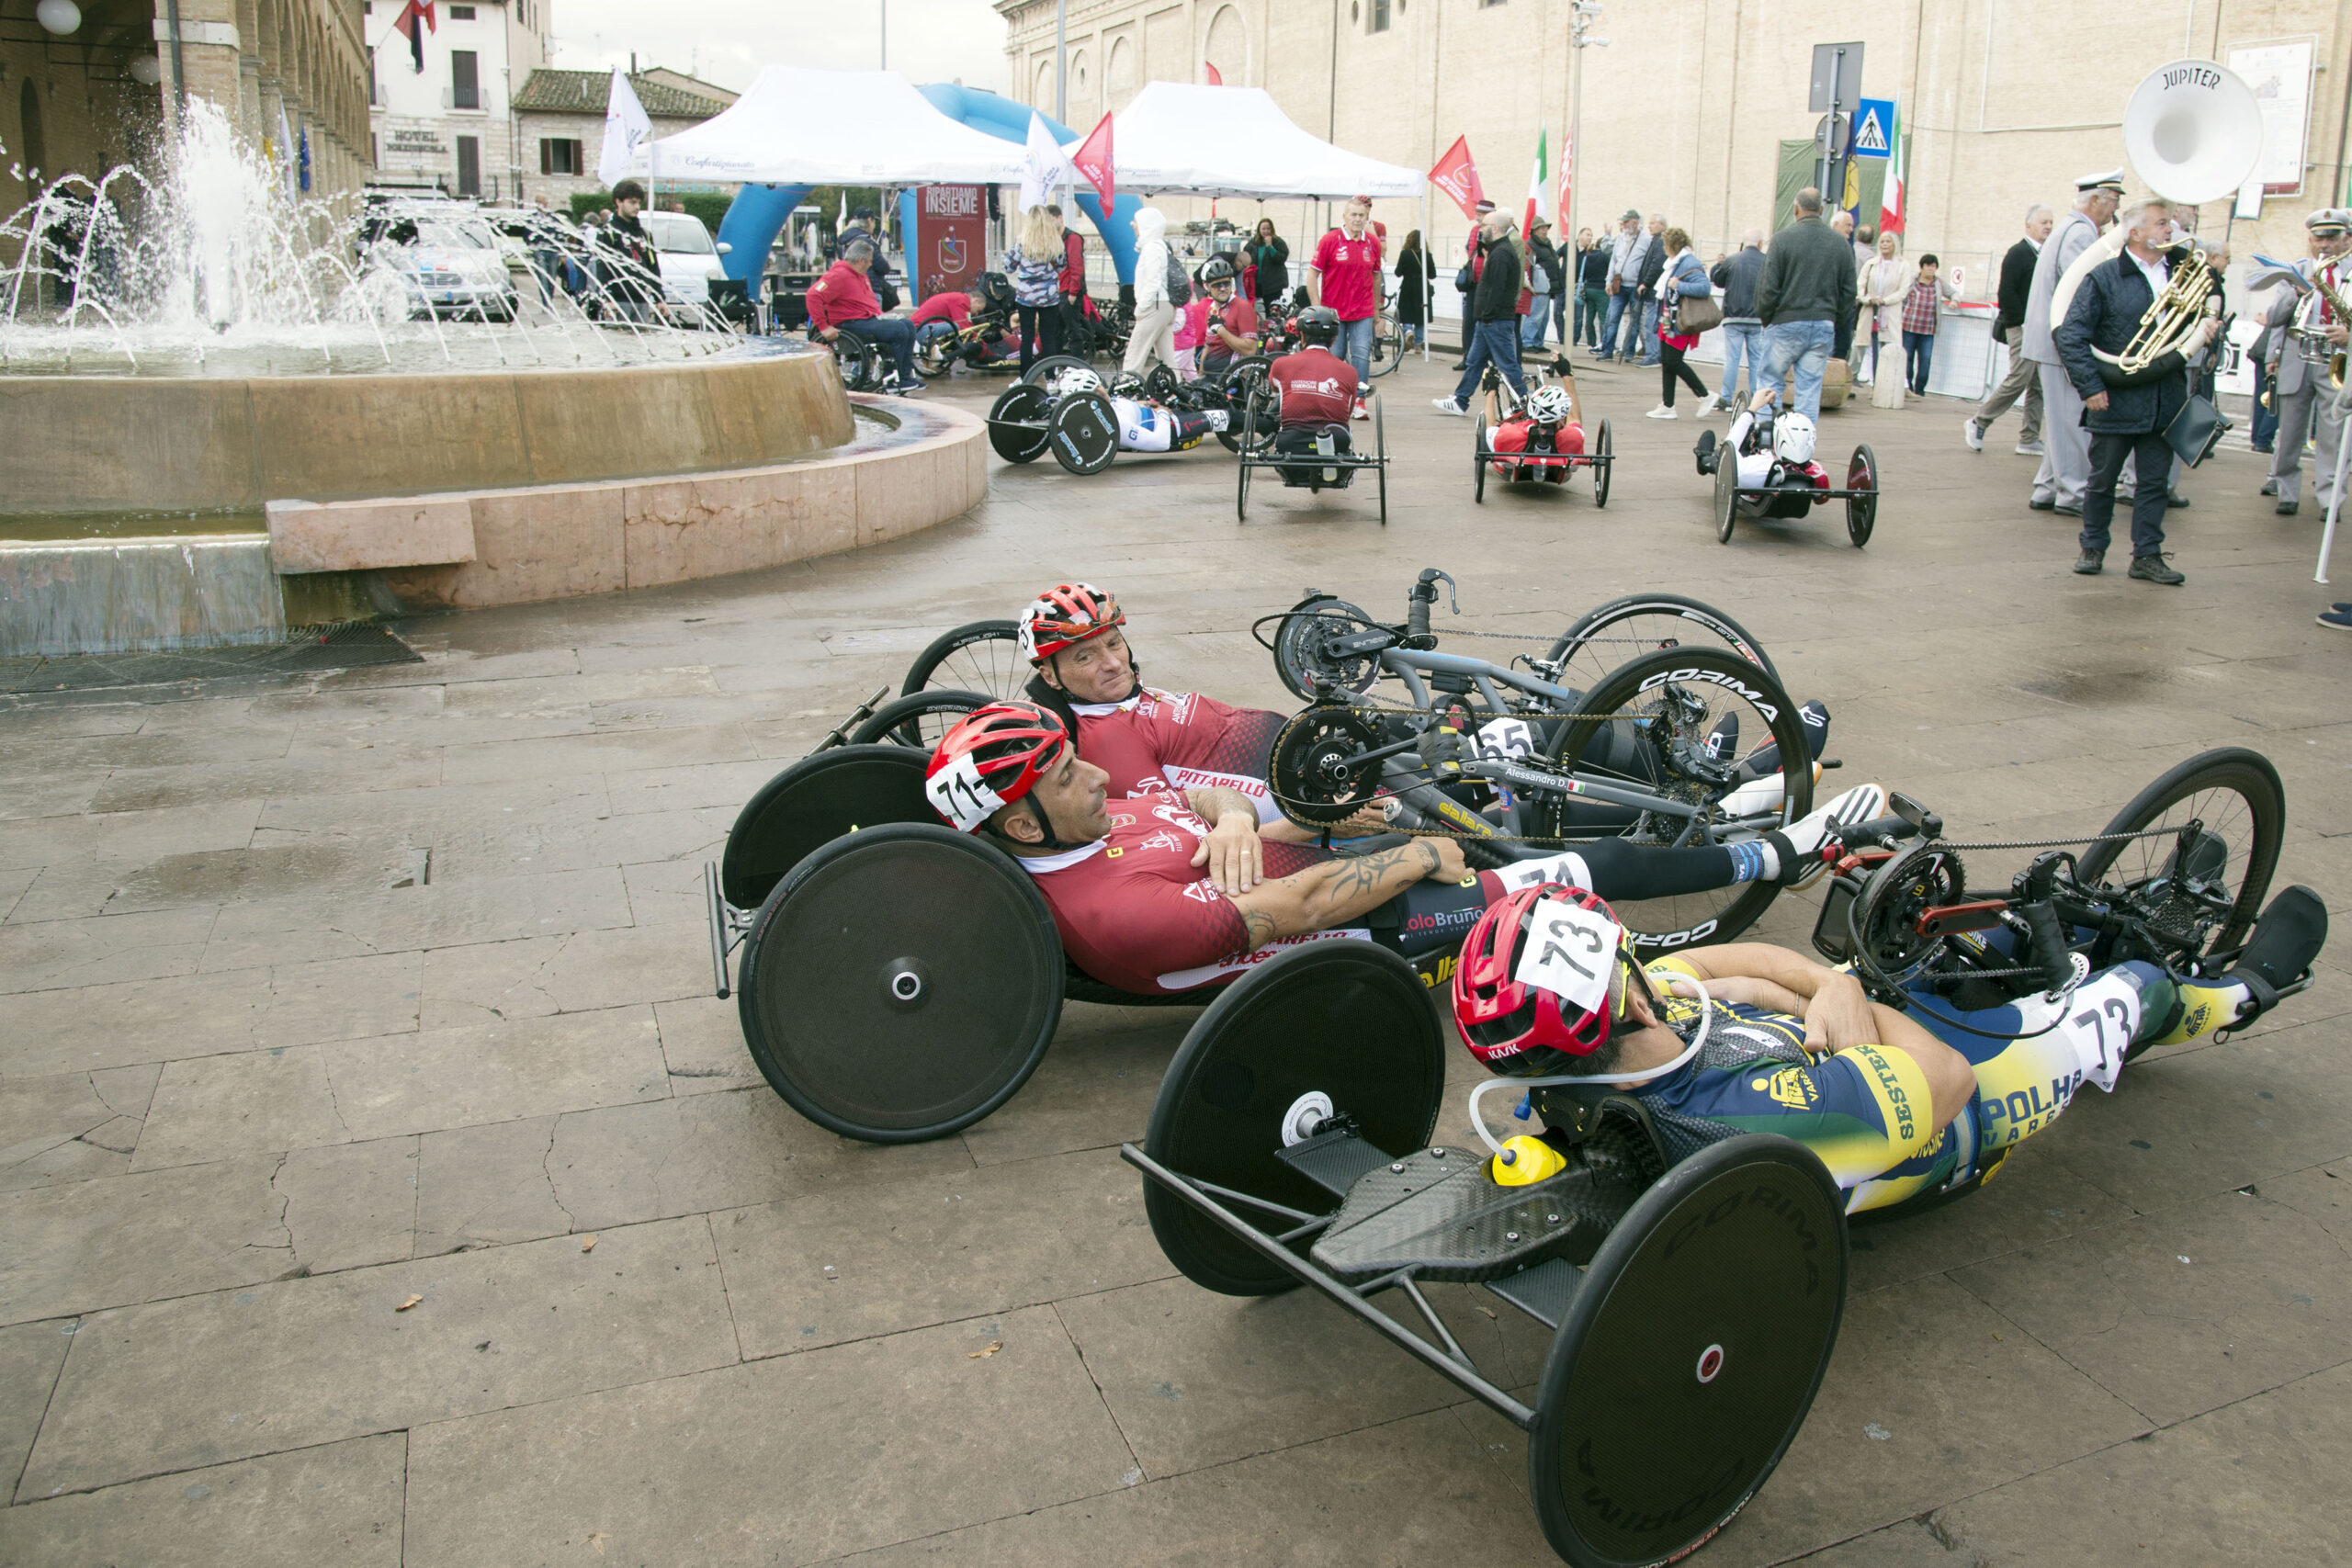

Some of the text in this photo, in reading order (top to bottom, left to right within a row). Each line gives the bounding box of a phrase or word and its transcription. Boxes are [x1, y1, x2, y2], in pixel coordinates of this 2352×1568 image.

[2163, 68, 2221, 90] JUPITER
[394, 130, 439, 142] HOTEL
[925, 197, 978, 213] INSIEME
[926, 186, 978, 198] RIPARTIAMO
[1213, 412, 1227, 428] 54
[1639, 668, 1779, 723] CORIMA
[1477, 725, 1532, 762] 65
[1177, 769, 1266, 797] PITTARELLO
[1505, 767, 1567, 788] Alessandro D.
[937, 772, 984, 820] 71
[1439, 802, 1492, 836] dallara
[1539, 919, 1603, 980] 73
[2072, 998, 2132, 1070] 73
[1487, 1043, 1521, 1060] KASK
[1981, 1068, 2082, 1131] POLHA
[1664, 1185, 1819, 1297] CORIMA
